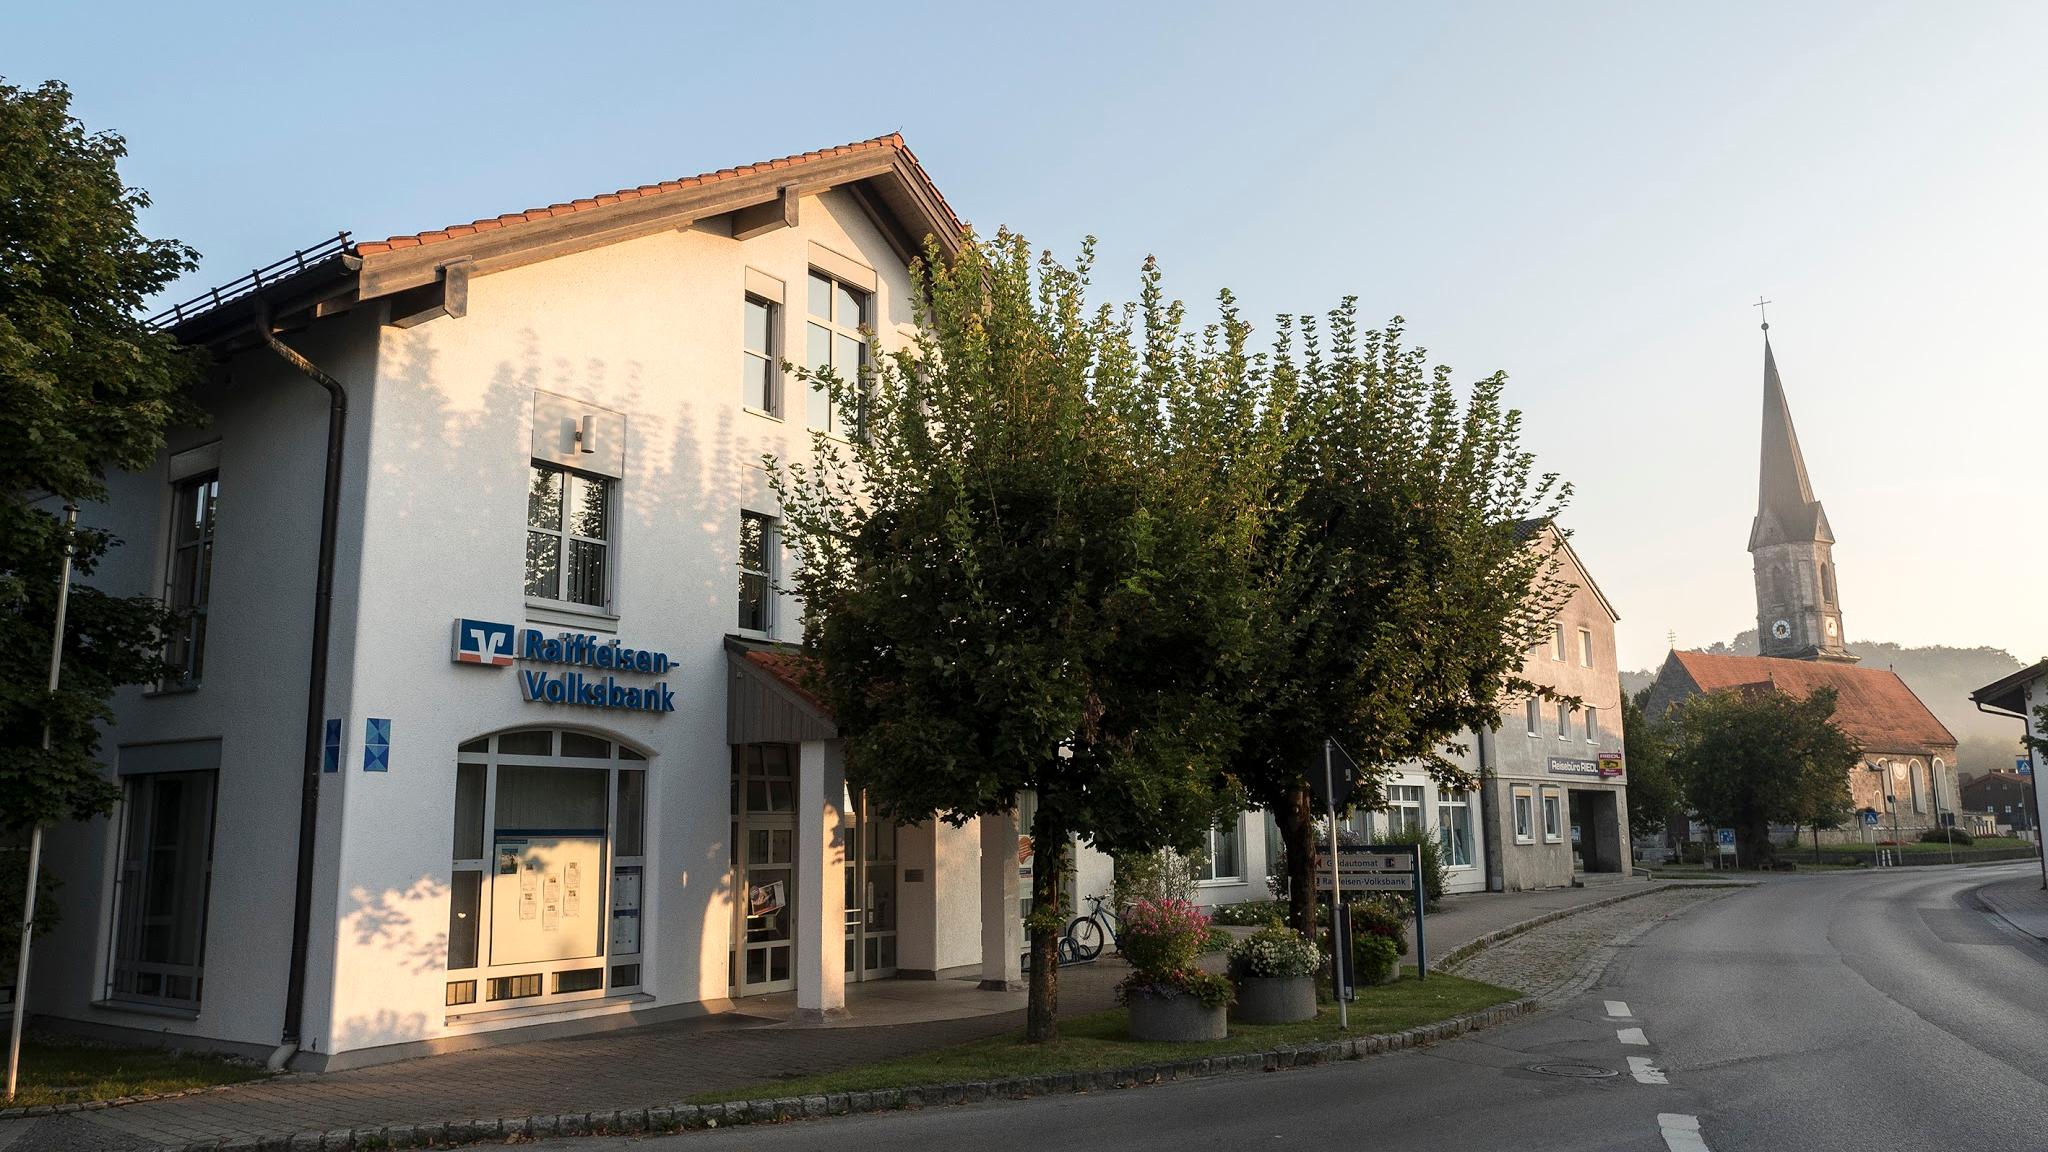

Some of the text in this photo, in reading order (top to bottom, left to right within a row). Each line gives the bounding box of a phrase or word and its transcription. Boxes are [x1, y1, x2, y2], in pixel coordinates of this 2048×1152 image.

[522, 629, 680, 674] Raiffeisen-
[522, 670, 675, 712] Volksbank
[1551, 760, 1580, 772] Reisebüro
[1580, 762, 1598, 773] RIEDL
[1326, 859, 1378, 867] Gldautomat
[1322, 877, 1406, 886] Raeisen-Volksbank
